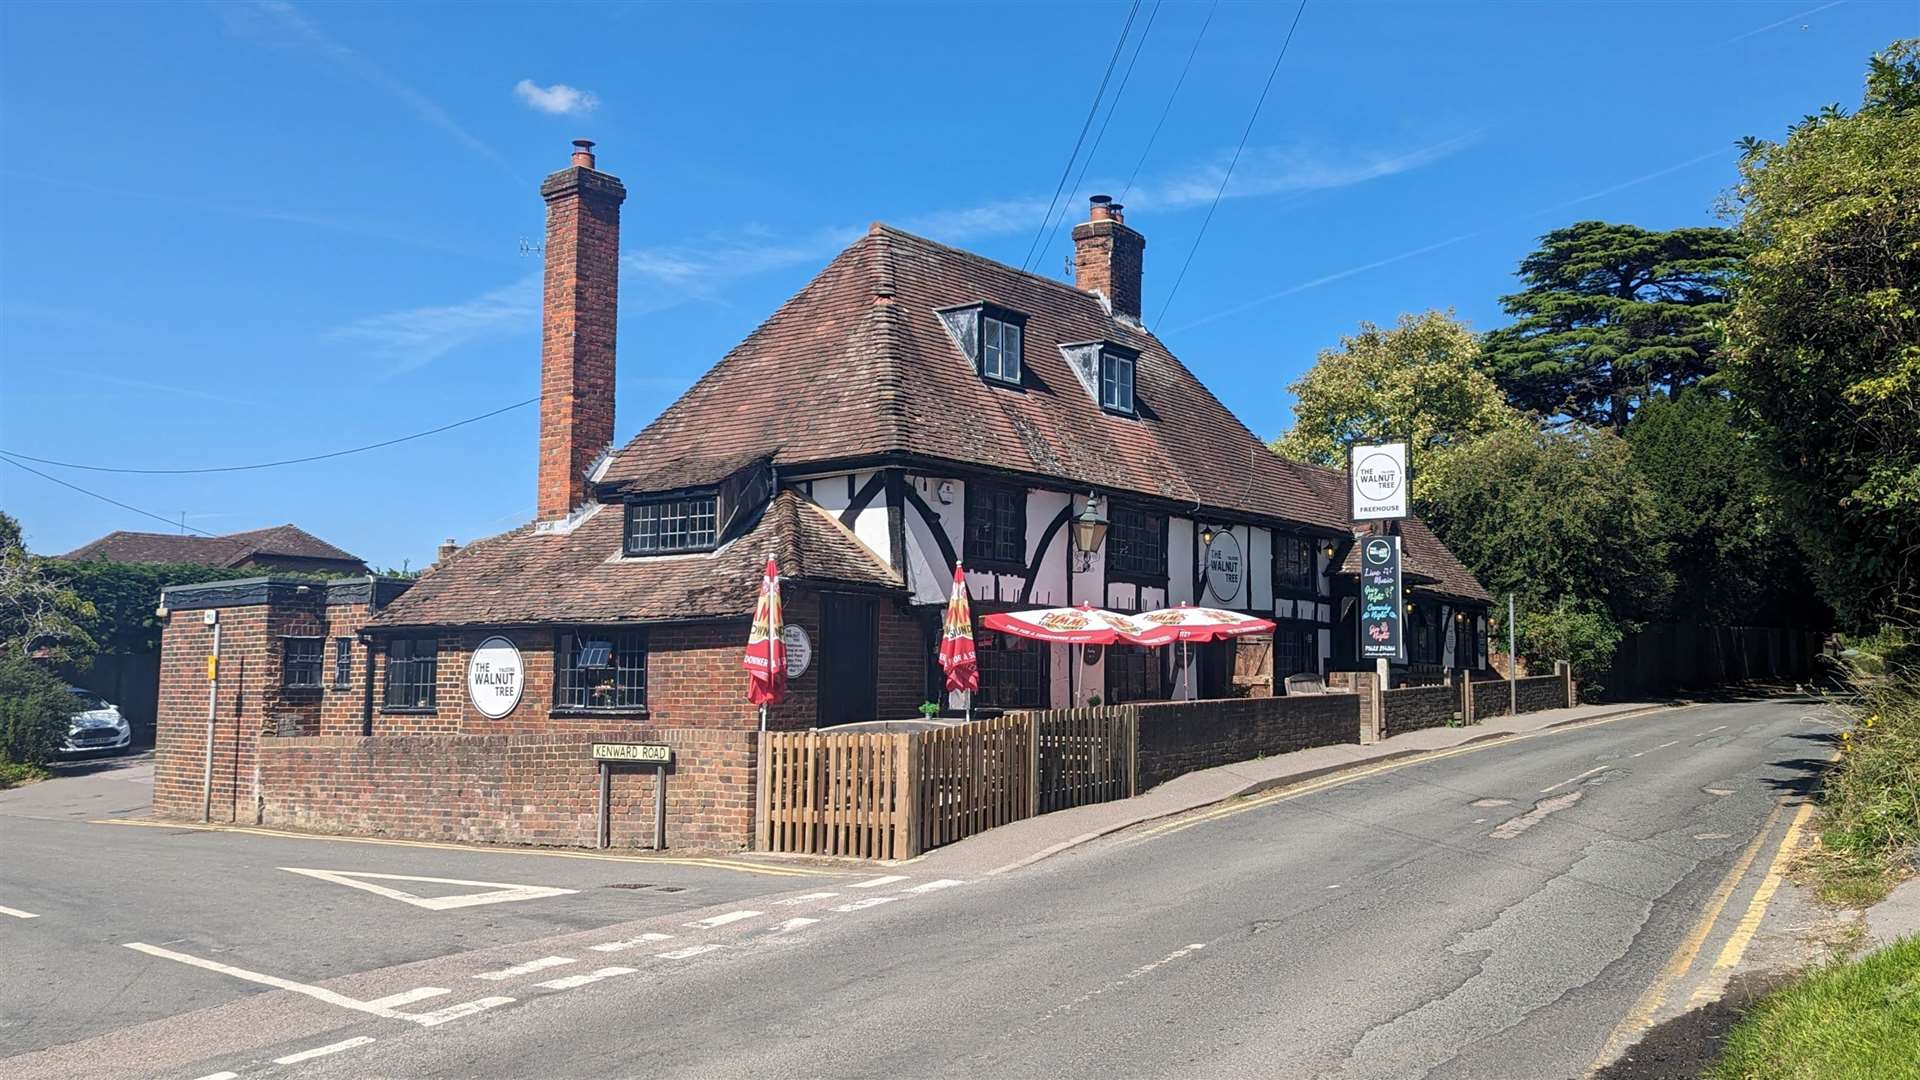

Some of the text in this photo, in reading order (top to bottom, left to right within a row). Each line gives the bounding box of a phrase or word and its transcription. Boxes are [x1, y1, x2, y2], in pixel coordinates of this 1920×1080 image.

[1360, 474, 1395, 483] WALNUT
[1211, 549, 1222, 559] THE
[1211, 560, 1238, 573] WALNUT
[1225, 573, 1238, 583] TREE
[475, 662, 491, 673] THE
[474, 673, 515, 685] WALNUT
[495, 686, 515, 696] TREE
[596, 745, 666, 760] KENWARD ROAD
